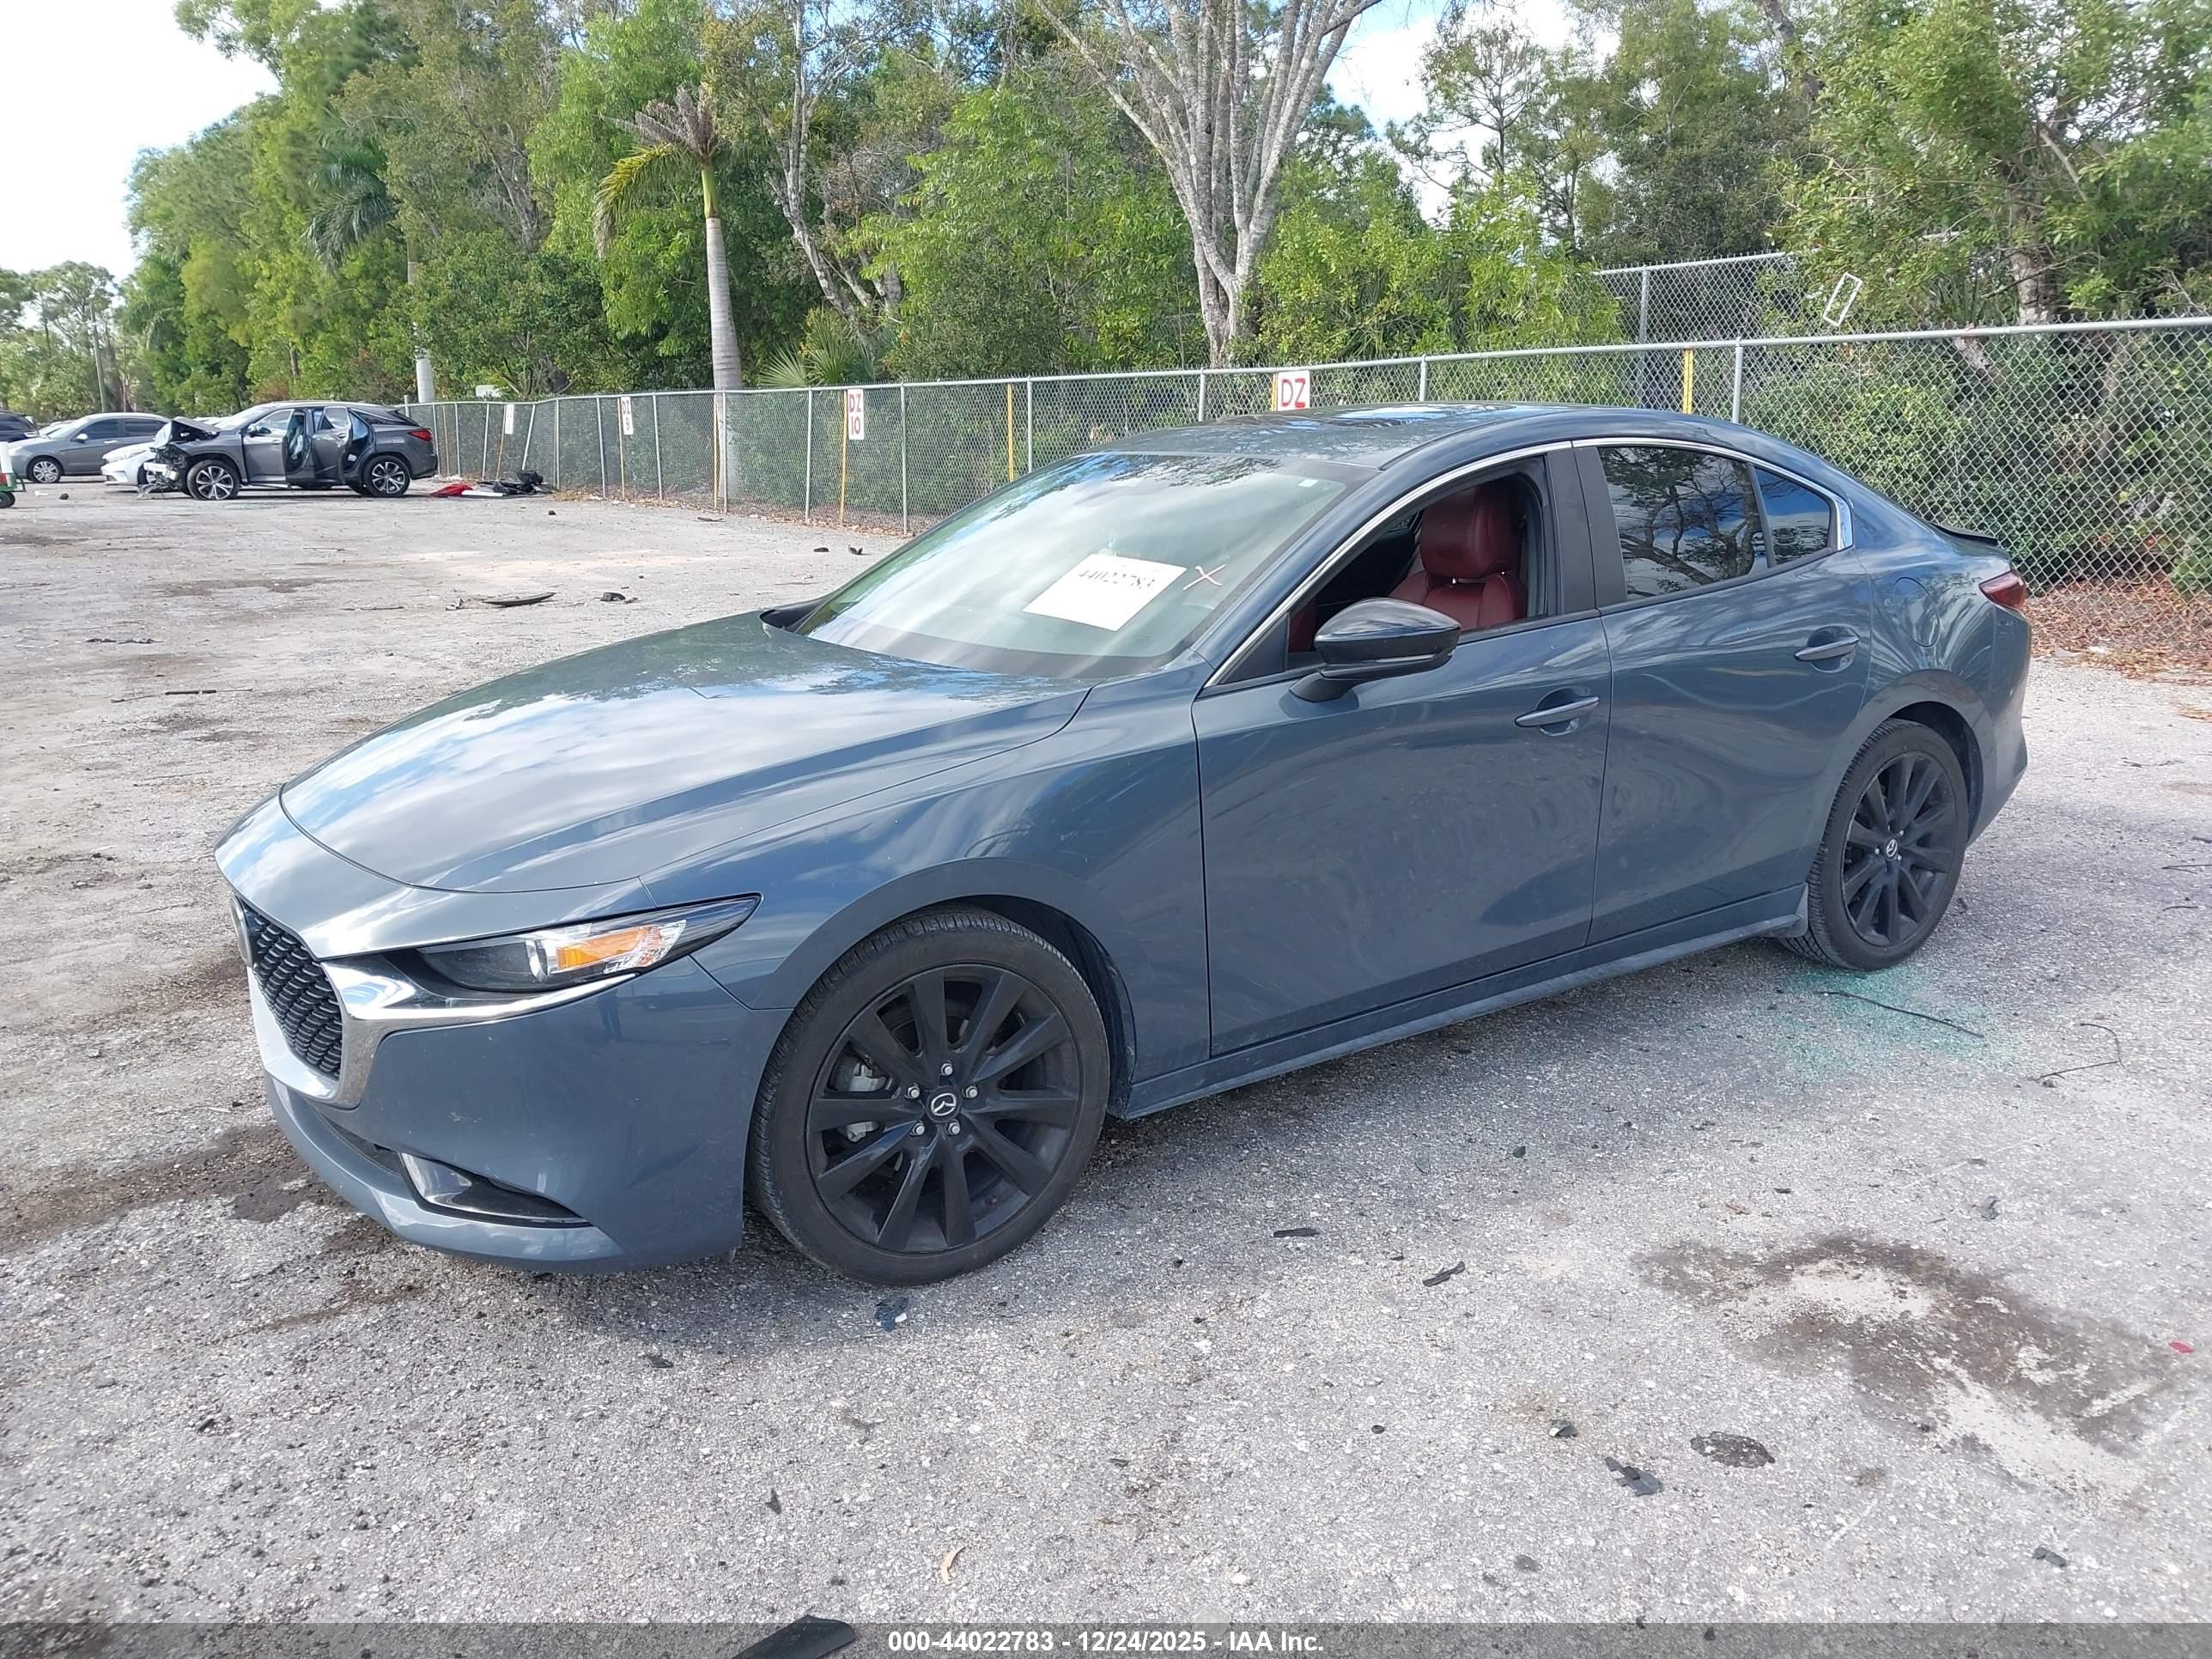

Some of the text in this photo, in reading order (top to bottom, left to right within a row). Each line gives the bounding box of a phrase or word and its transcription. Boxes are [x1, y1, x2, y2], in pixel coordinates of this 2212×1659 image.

[848, 393, 862, 413] DZ
[1280, 378, 1306, 409] DZ
[851, 416, 861, 435] 10
